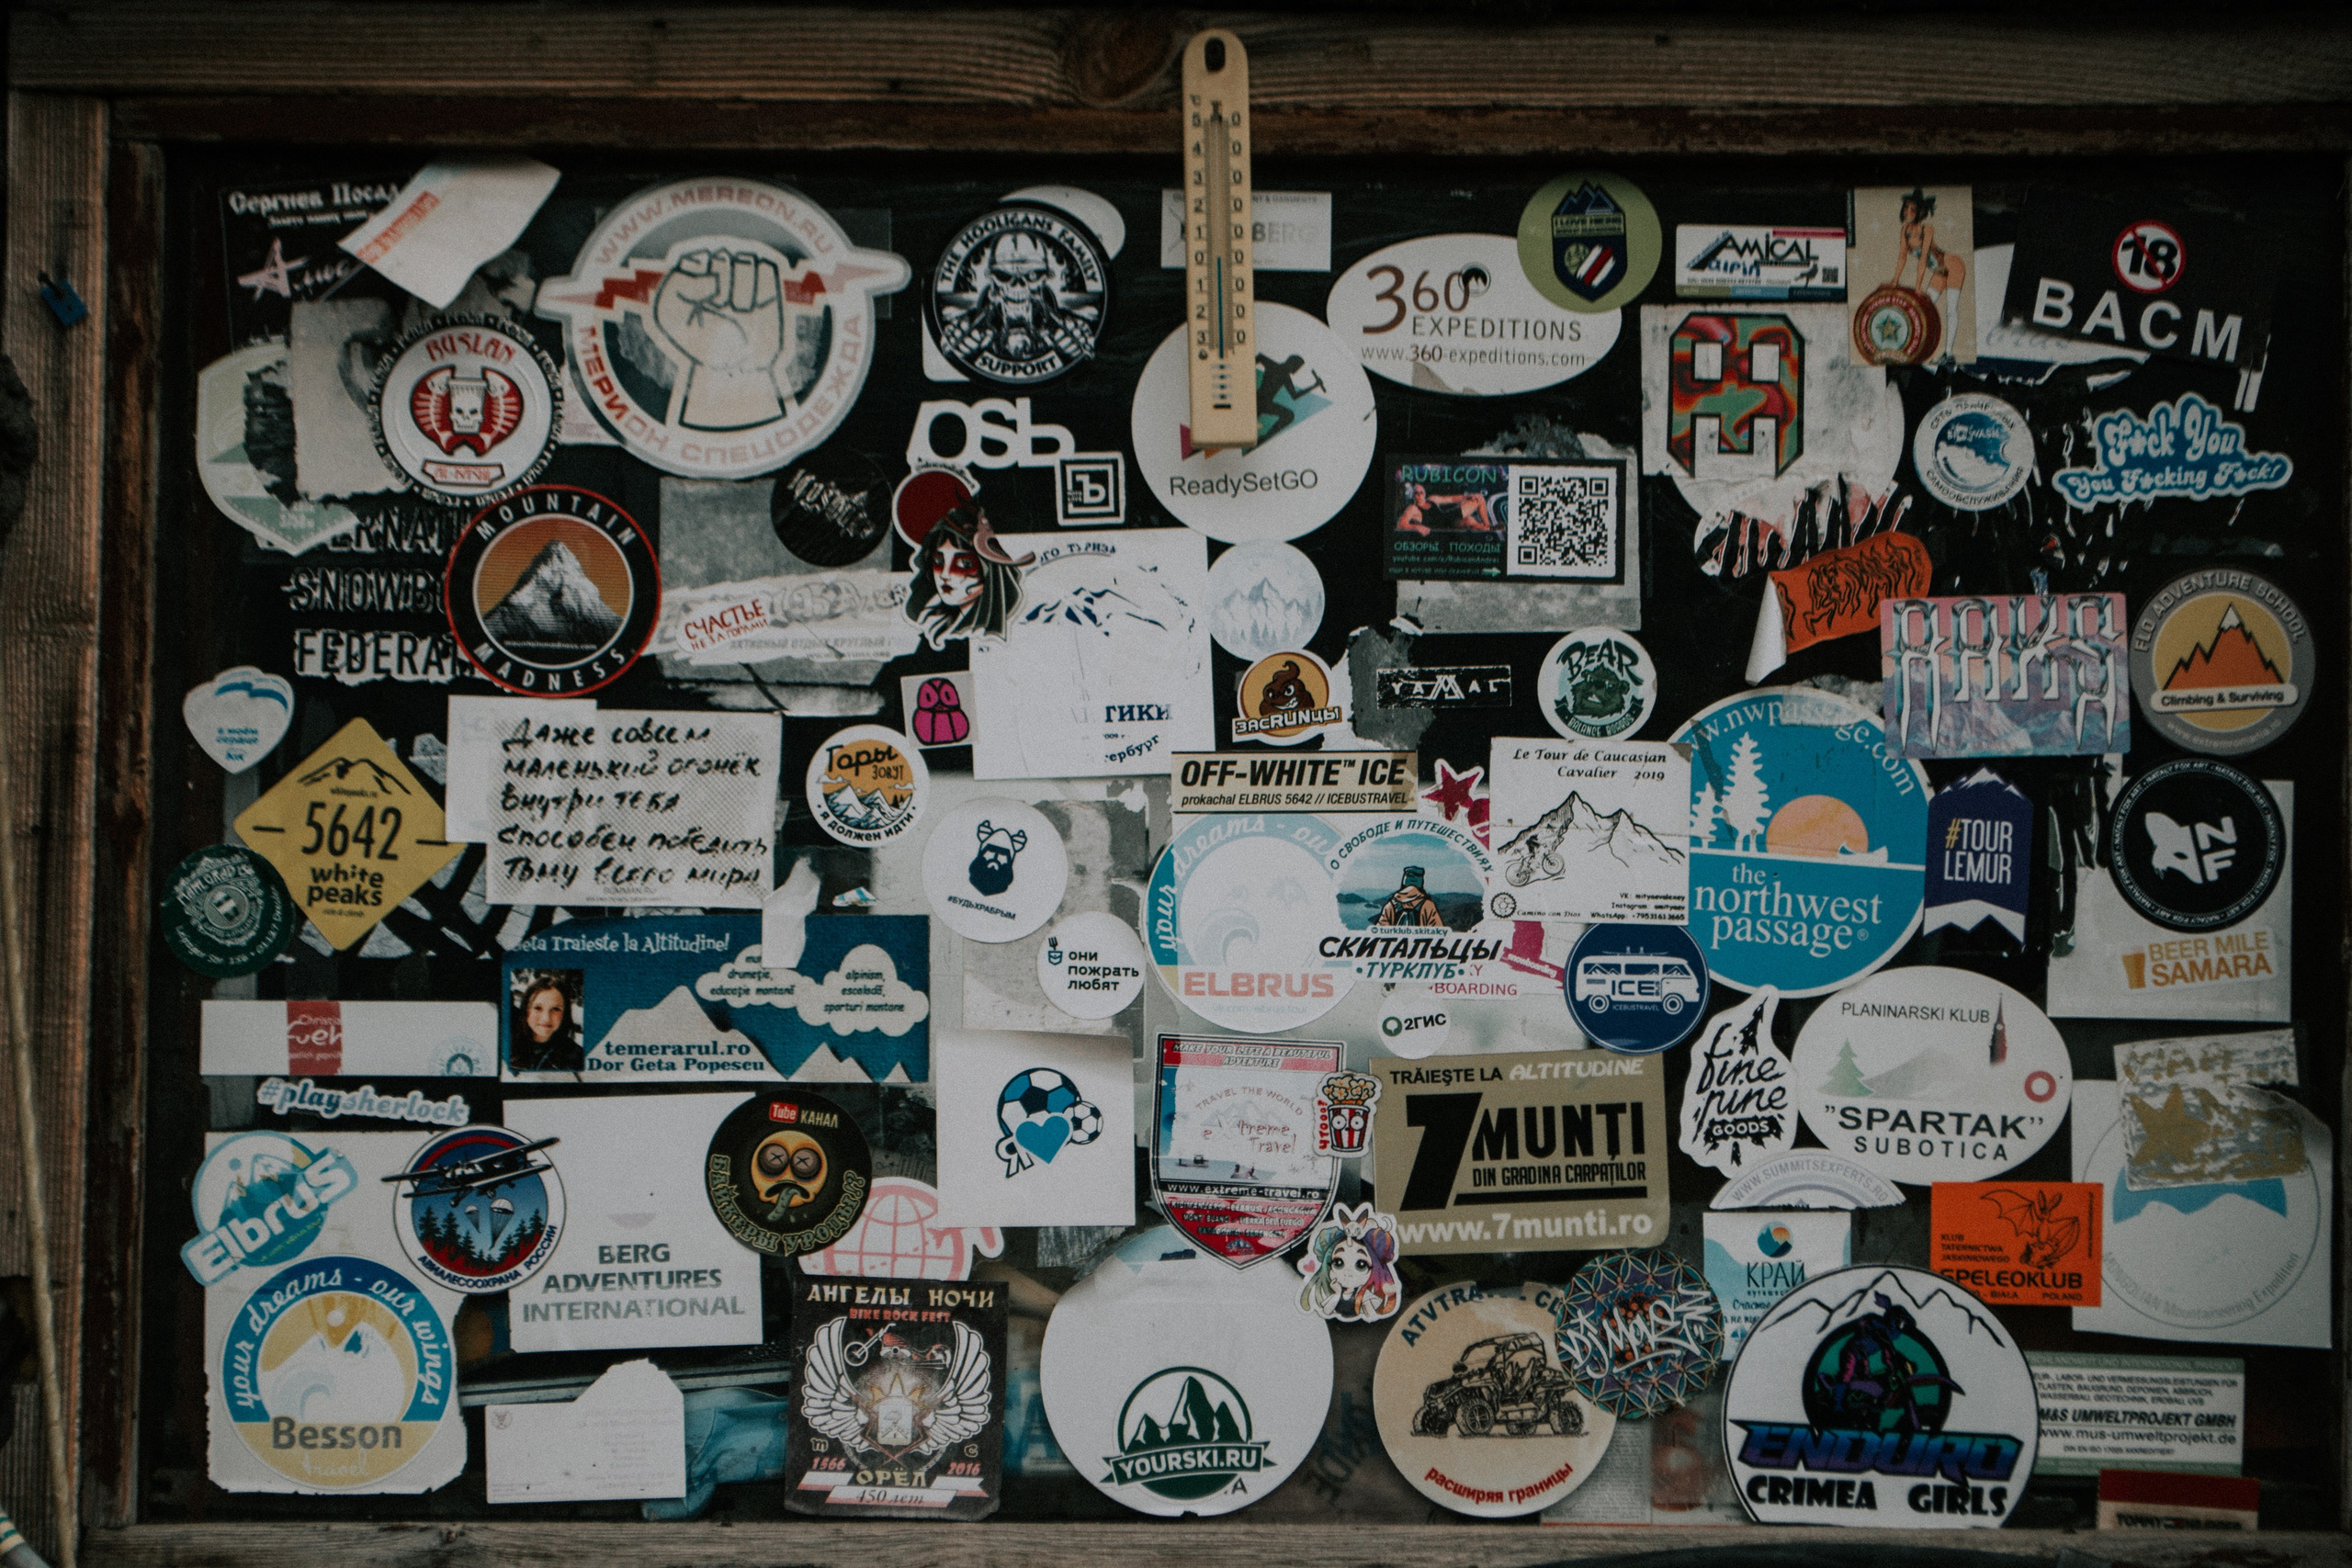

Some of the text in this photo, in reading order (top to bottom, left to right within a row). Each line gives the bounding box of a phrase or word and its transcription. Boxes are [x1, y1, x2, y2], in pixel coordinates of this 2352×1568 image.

[596, 186, 835, 266] WWW.MEREON.RU
[939, 214, 1101, 284] THE HOOLIGANS FAMILY
[2124, 235, 2177, 283] 18
[1363, 265, 1472, 334] 360
[1411, 316, 1582, 342] EXPEDITIONS
[425, 332, 515, 364] RUSLAN
[1360, 343, 1586, 367] www.360-expeditions.com
[978, 354, 1059, 377] SUPPORT
[577, 325, 670, 452] МЕРИОН
[2183, 395, 2239, 461] You
[1170, 469, 1318, 497] ReadySetGO
[1401, 465, 1498, 484] RUBICON
[476, 492, 637, 547] MOUNTAIN
[2154, 570, 2251, 616] ADVENTURE
[2256, 581, 2309, 642] SCHOOL
[684, 599, 766, 640] СЧАСТЬЕ
[472, 645, 627, 692] MADNESS
[1556, 637, 1644, 686] BEAR
[2161, 690, 2285, 707] Climbing & Surviving
[503, 717, 710, 752] Даже совсем
[1568, 715, 1634, 737] BALANCE BOARDS
[1514, 748, 1668, 764] Le Tour de Caucasian
[872, 763, 905, 781] ЗОВУТ
[1359, 759, 1408, 786] ICE
[1557, 765, 1667, 783] Cavalier 2019
[1182, 793, 1235, 807] prokachal
[1238, 793, 1283, 806] ELBRUS
[1284, 793, 1313, 806] 5642
[1327, 792, 1408, 806] ICEBUSTRAVEL
[301, 800, 402, 861] 5642
[829, 818, 882, 842] ДОЛЖЕН
[883, 811, 911, 837] ИДТИ
[1945, 818, 2013, 853] #TOUR
[1339, 821, 1391, 860] СВОБОДЕ
[1407, 818, 1496, 874] ПУТЕШЕСТВИЯХ
[310, 863, 384, 889] white
[1732, 863, 1767, 885] the
[1943, 849, 2012, 885] LEMUR
[306, 882, 383, 908] peaks
[947, 895, 1016, 920] #БУДЬХРАБРЫМ
[1693, 874, 1883, 925] northwest
[1155, 885, 1184, 952] your
[551, 934, 620, 953] Traieste
[623, 932, 639, 952] la
[642, 932, 730, 954] Altitudine!
[1319, 936, 1503, 964] СКИТАЛЬЦЫ
[2148, 931, 2268, 964] BEER MILE
[1069, 951, 1099, 962] они
[1068, 965, 1139, 981] пожрать
[2151, 953, 2273, 988] SAMARA
[1068, 978, 1120, 991] любят
[1184, 972, 1334, 998] ELBRUS
[1611, 979, 1656, 996] ICE
[823, 1002, 905, 1014] sporturi montane
[1611, 1004, 1661, 1012] ICEBUSTRAVEL
[1841, 1001, 1990, 1023] PLANINARSKI KLUB
[1404, 1012, 1447, 1031] 2ГИС
[605, 1040, 752, 1057] temerarul.ro
[1173, 1043, 1203, 1055] MAKE
[1205, 1044, 1234, 1055] YOUR
[1236, 1045, 1262, 1056] LIFE
[1272, 1048, 1332, 1059] BEAUTIFUL
[588, 1057, 765, 1075] Dor Geta Popescu
[1221, 1057, 1280, 1068] ADVENTURE
[1479, 1066, 1503, 1082] LA
[1509, 1058, 1645, 1082] ALTITUDINE
[261, 1082, 466, 1122] #playsherlock
[772, 1104, 797, 1122] Tube
[1196, 1086, 1305, 1117] TRAVEL THE WORLD
[800, 1109, 838, 1128] КАНАЛ
[1712, 1118, 1770, 1137] GOODS
[1854, 1135, 2008, 1162] SUBOTICA
[1473, 1168, 1497, 1188] DIN
[1501, 1164, 1562, 1186] GRADINA
[1731, 1159, 1890, 1202] WWW.SUMMITSEXPERTS.RO
[1167, 1182, 1320, 1201] www.extreme-travel.ro
[193, 1154, 351, 1280] Elbrus
[1397, 1209, 1654, 1245] www.7munti.ro
[523, 1224, 558, 1269] РОССИИ
[1940, 1233, 1964, 1242] KLUB
[1940, 1243, 2004, 1253] TATERNICTWA
[599, 1244, 670, 1264] BERG
[1940, 1254, 2011, 1264] JASKINIOWEGO
[542, 1269, 721, 1294] ADVENTURES
[1747, 1260, 1805, 1288] КРАЙ
[1939, 1269, 2083, 1290] SPELEOKLUB
[2252, 1251, 2301, 1304] Expedition
[806, 1284, 995, 1308] АНГЕЛЫ НОЧИ
[522, 1297, 745, 1323] INTERNATIONAL
[848, 1308, 952, 1323] BIKE ROCK FEST
[232, 1268, 448, 1409] your dreams our wings
[2072, 1408, 2193, 1427] UMWELTPROJEKT
[2193, 1414, 2238, 1428] GMBH
[272, 1416, 402, 1450] Besson
[2038, 1427, 2238, 1446] www.mus-umweltprojekt.de
[811, 1457, 847, 1471] 1566
[1118, 1449, 1259, 1481] YOURSKI.RU
[1738, 1420, 2024, 1486] ENDURO
[855, 1467, 927, 1487] ОРЁЛ
[946, 1461, 981, 1475] 2016
[855, 1489, 925, 1504] 450 лет
[1424, 1462, 1574, 1505] расширяя границы
[1746, 1475, 2009, 1517] CRIMEA GIRLS
